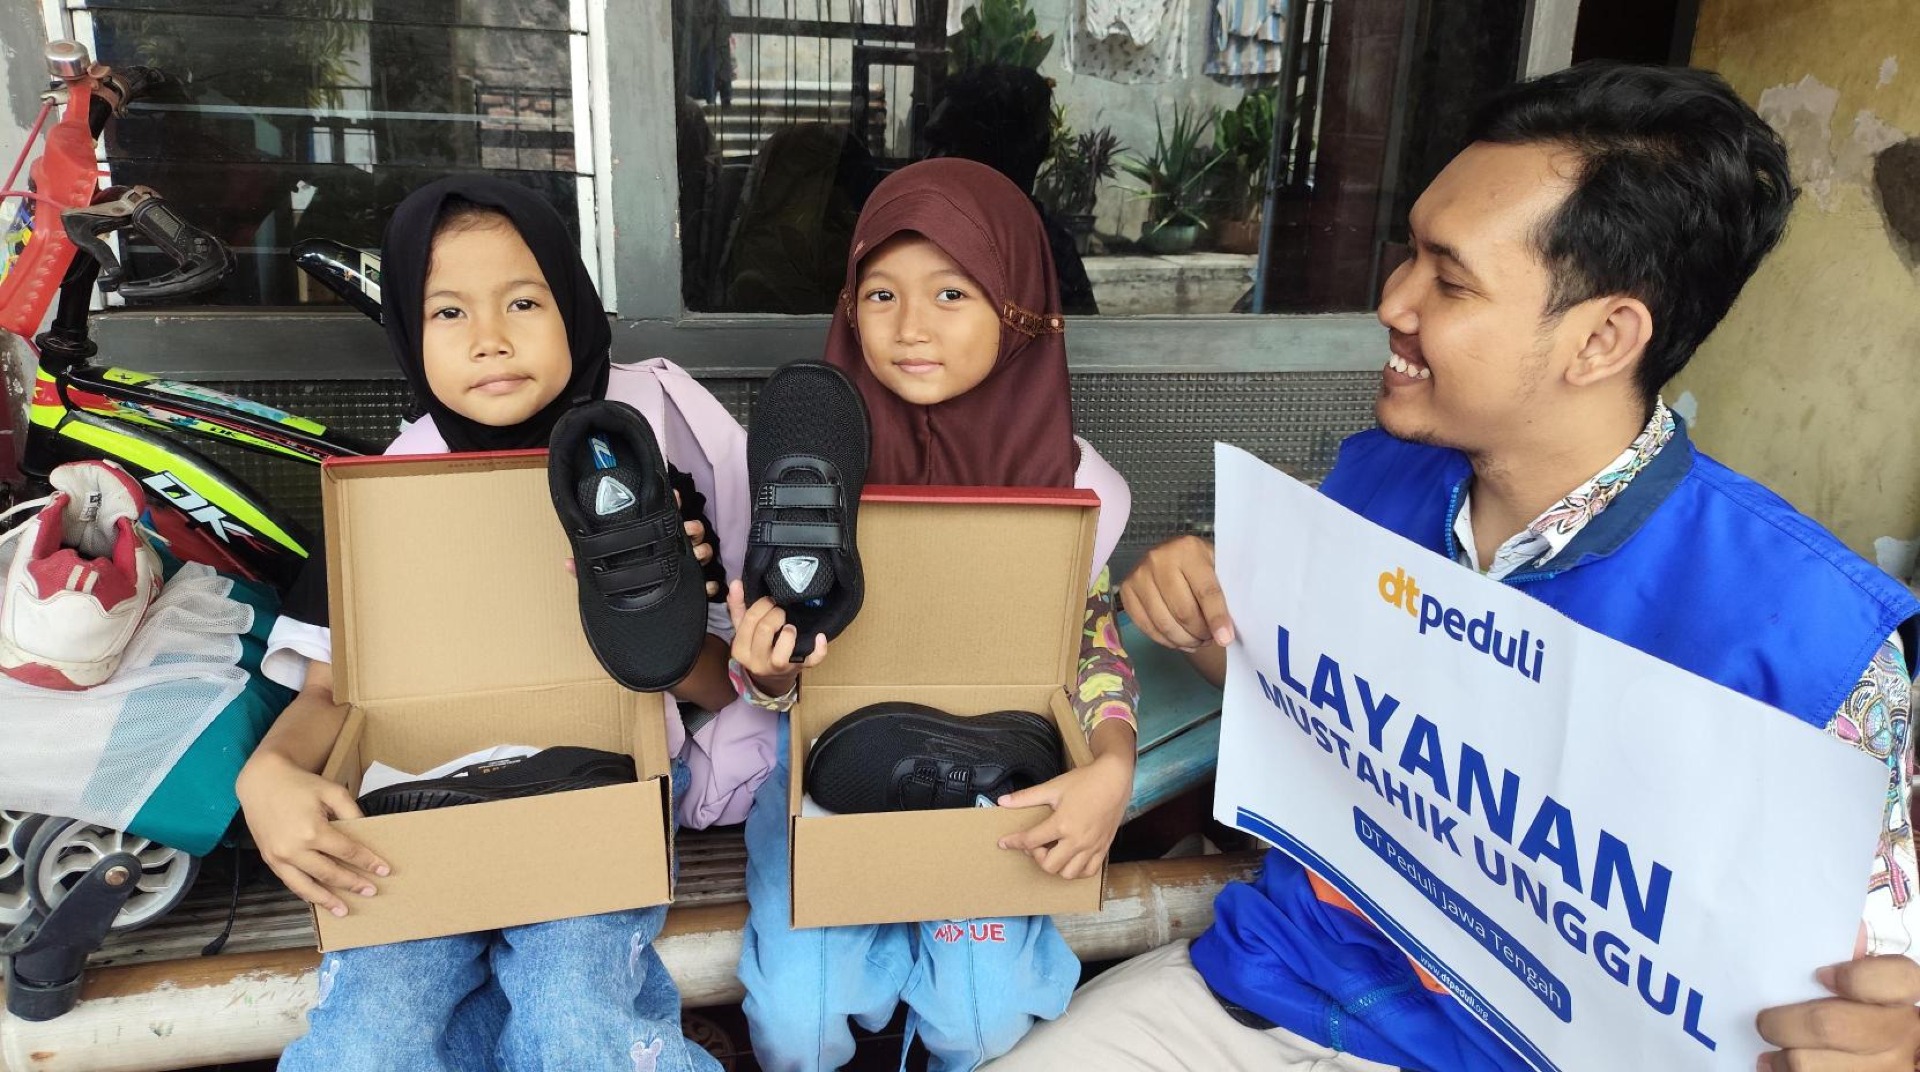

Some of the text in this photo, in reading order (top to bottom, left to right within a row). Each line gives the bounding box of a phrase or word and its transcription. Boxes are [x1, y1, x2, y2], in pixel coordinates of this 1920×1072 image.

[142, 470, 254, 544] DK
[1256, 669, 1717, 1052] MUSTAHIK UNGGUL
[1277, 624, 1673, 945] LAYANAN
[1361, 820, 1562, 1010] DT Peduli Jawa Tengah
[1420, 954, 1489, 1021] www.dtpeduli.org
